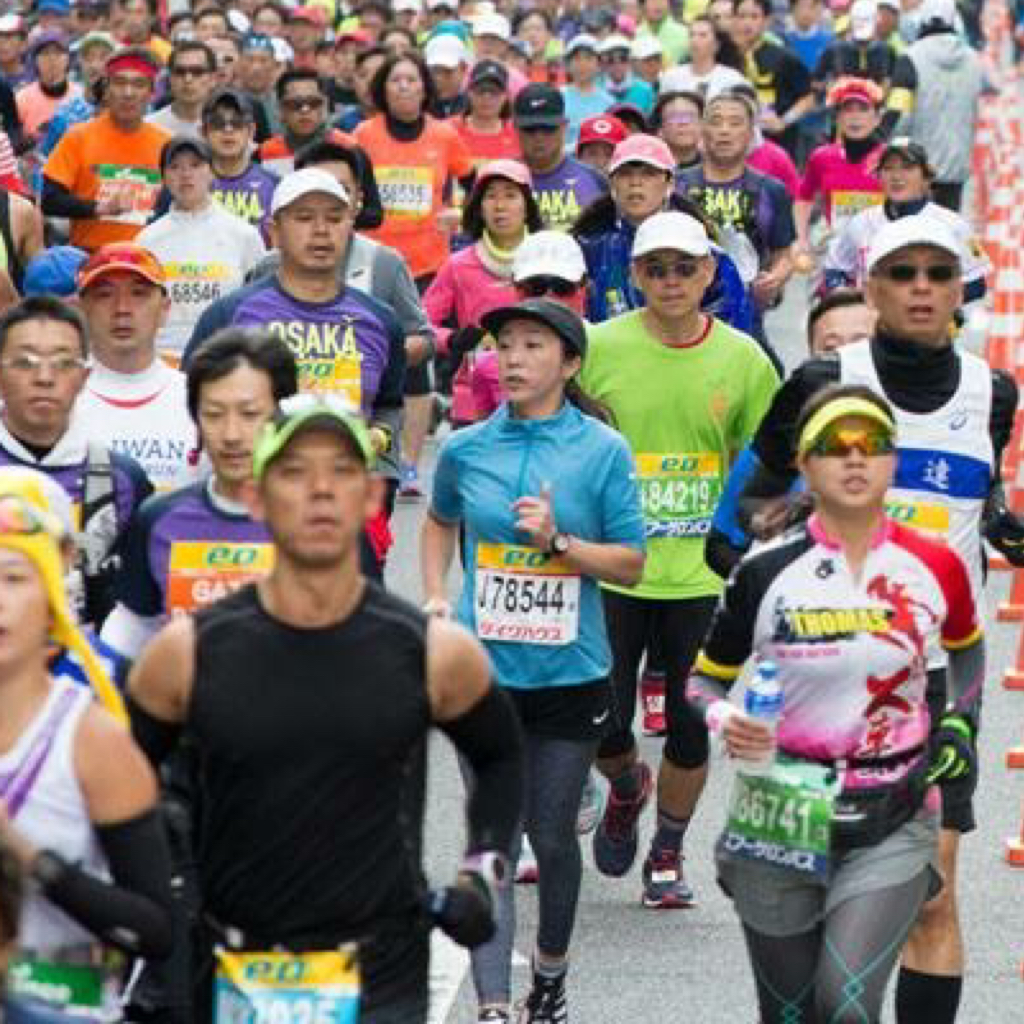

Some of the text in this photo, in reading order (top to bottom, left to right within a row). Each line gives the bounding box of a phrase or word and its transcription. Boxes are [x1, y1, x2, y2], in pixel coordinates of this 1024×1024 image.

[212, 188, 260, 218] SAKA
[268, 321, 357, 359] OSAKA
[640, 479, 711, 515] 84219
[205, 547, 258, 566] eo
[503, 547, 550, 568] eo
[243, 956, 308, 983] eo
